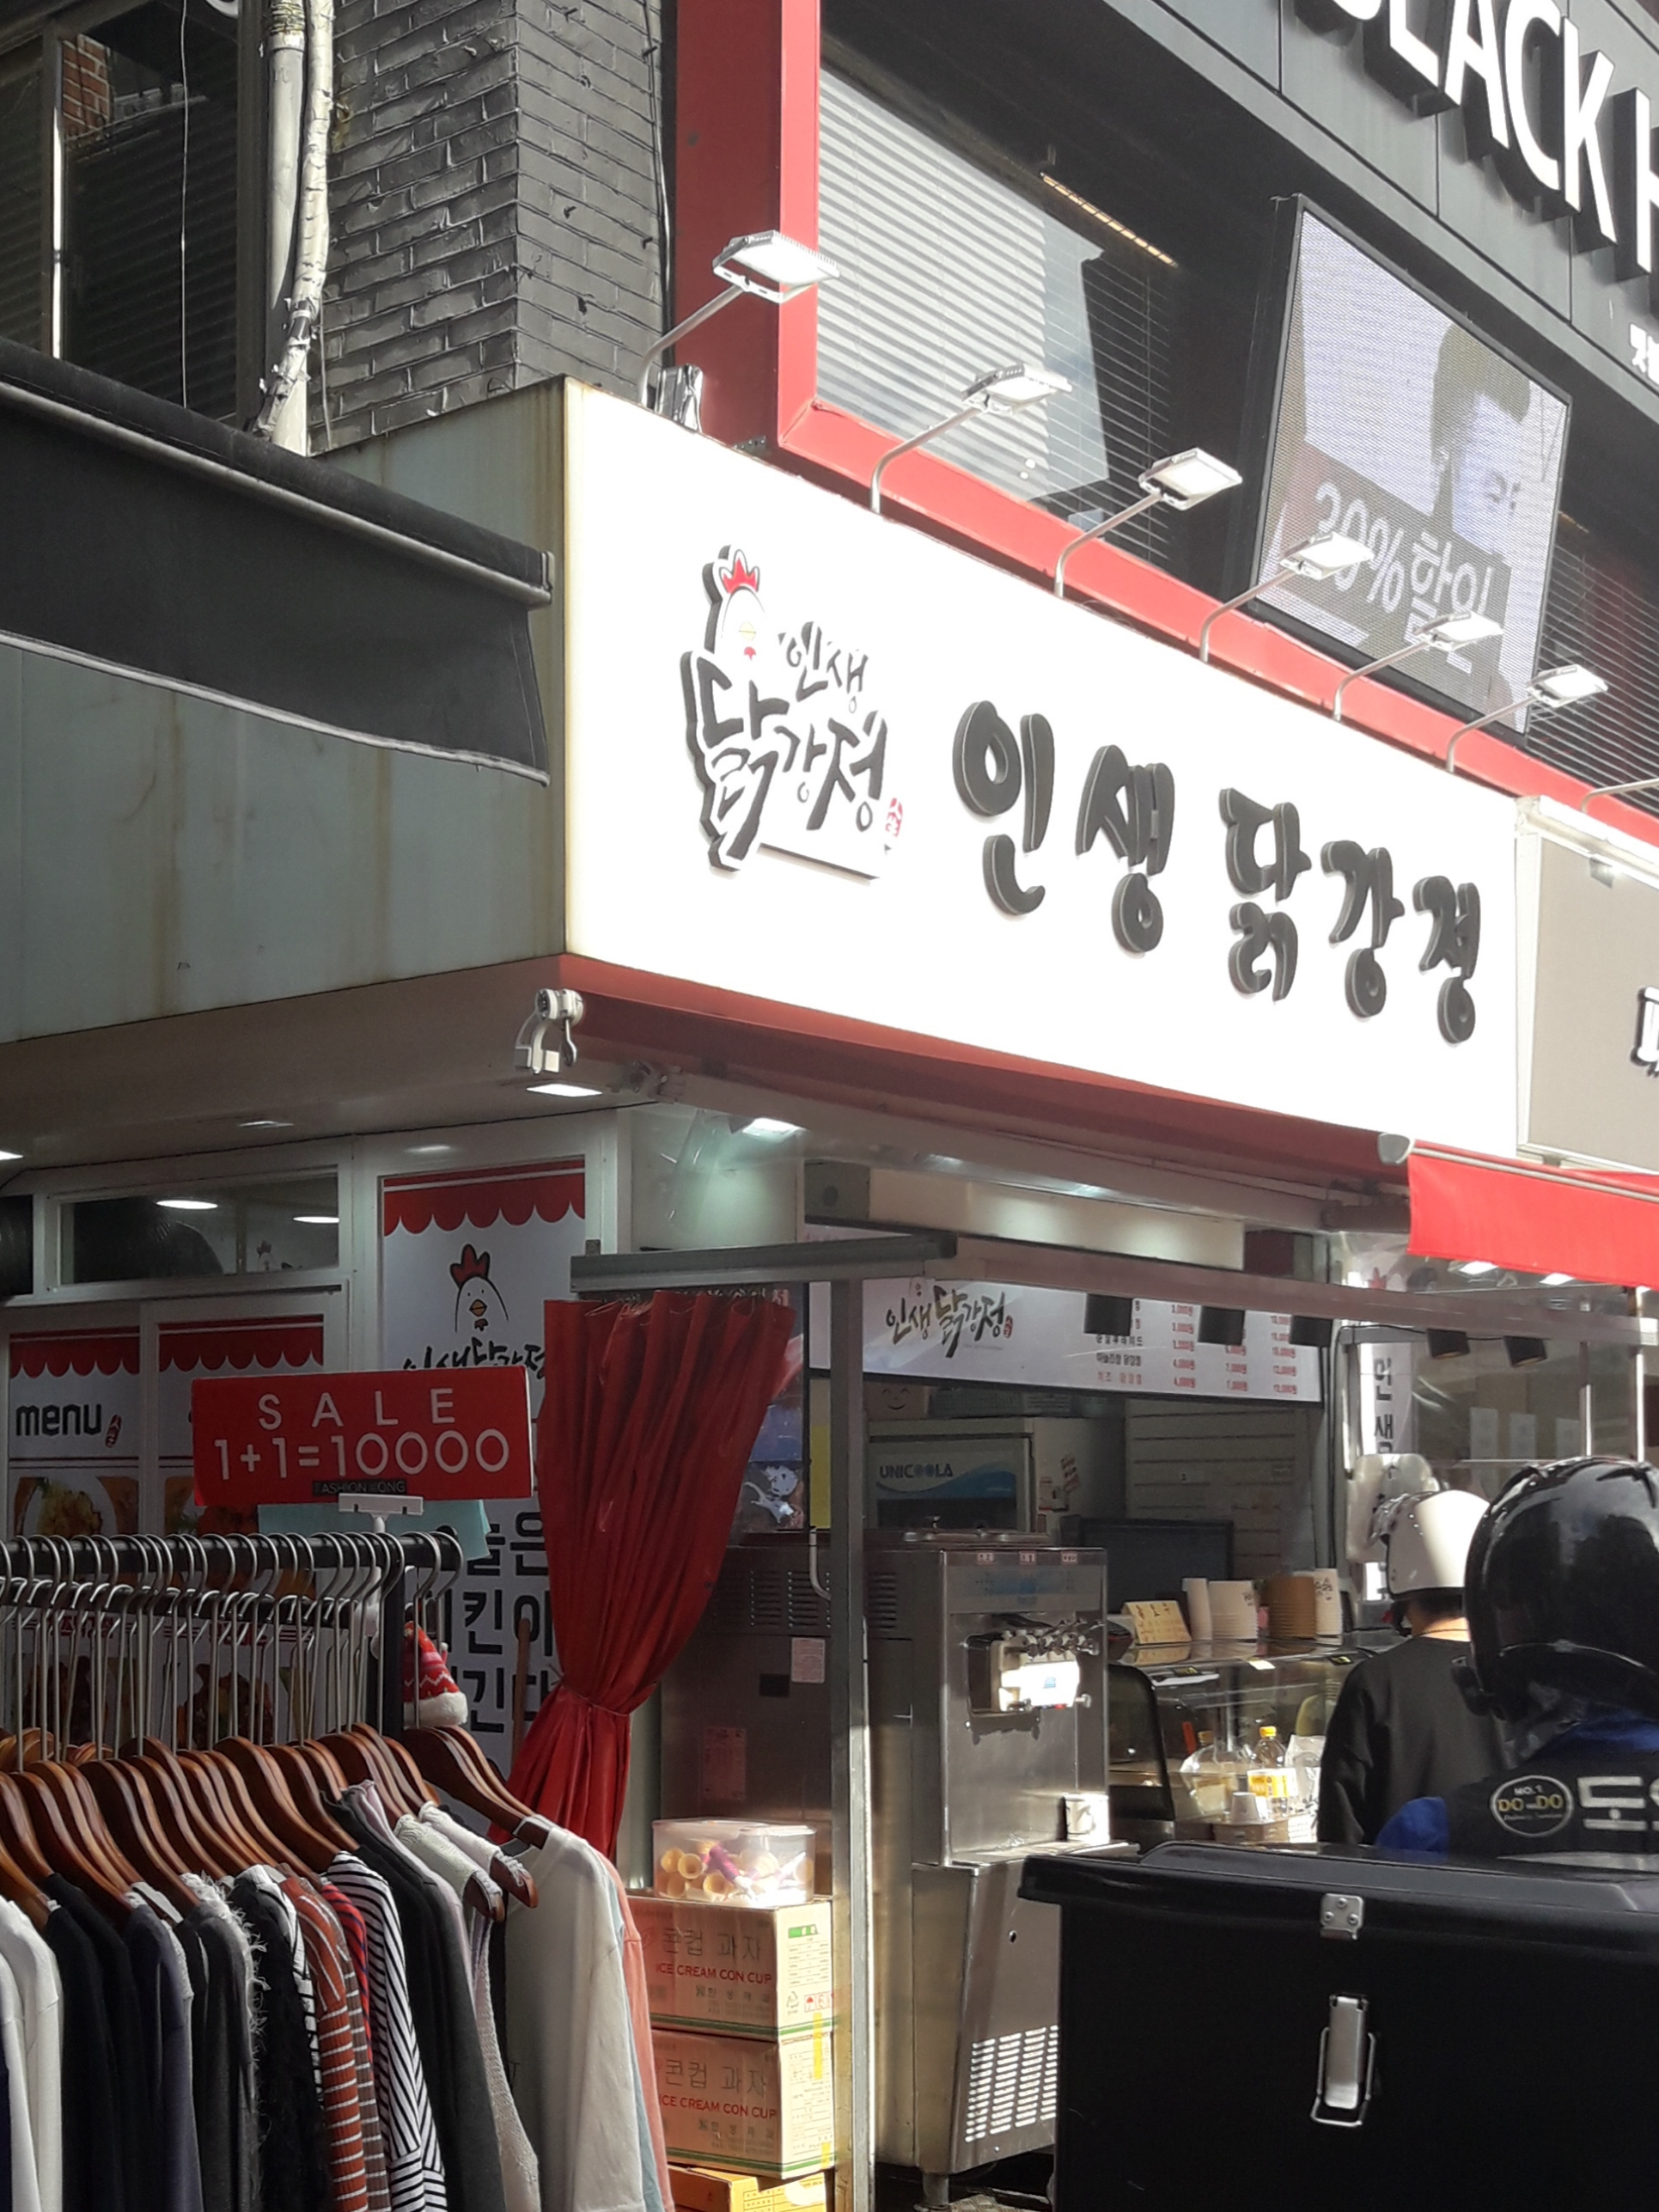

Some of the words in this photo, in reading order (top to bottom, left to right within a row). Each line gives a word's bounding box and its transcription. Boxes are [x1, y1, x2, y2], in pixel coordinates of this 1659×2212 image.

[1331, 0, 1617, 244] LACK
[778, 620, 869, 714] 인생
[952, 700, 1174, 954] 인생
[1219, 787, 1482, 1044] 닭강정
[15, 1403, 102, 1436] menu
[214, 1428, 509, 1480] 1+1=10000
[677, 1965, 717, 1978] CREAM
[719, 1969, 745, 1983] CON
[747, 1971, 772, 1984] CUP
[666, 2059, 707, 2089] 콘컵
[721, 2065, 767, 2097] 과자
[680, 2097, 720, 2111] CREAM
[723, 2103, 748, 2117] CON
[751, 2107, 777, 2120] CUP
